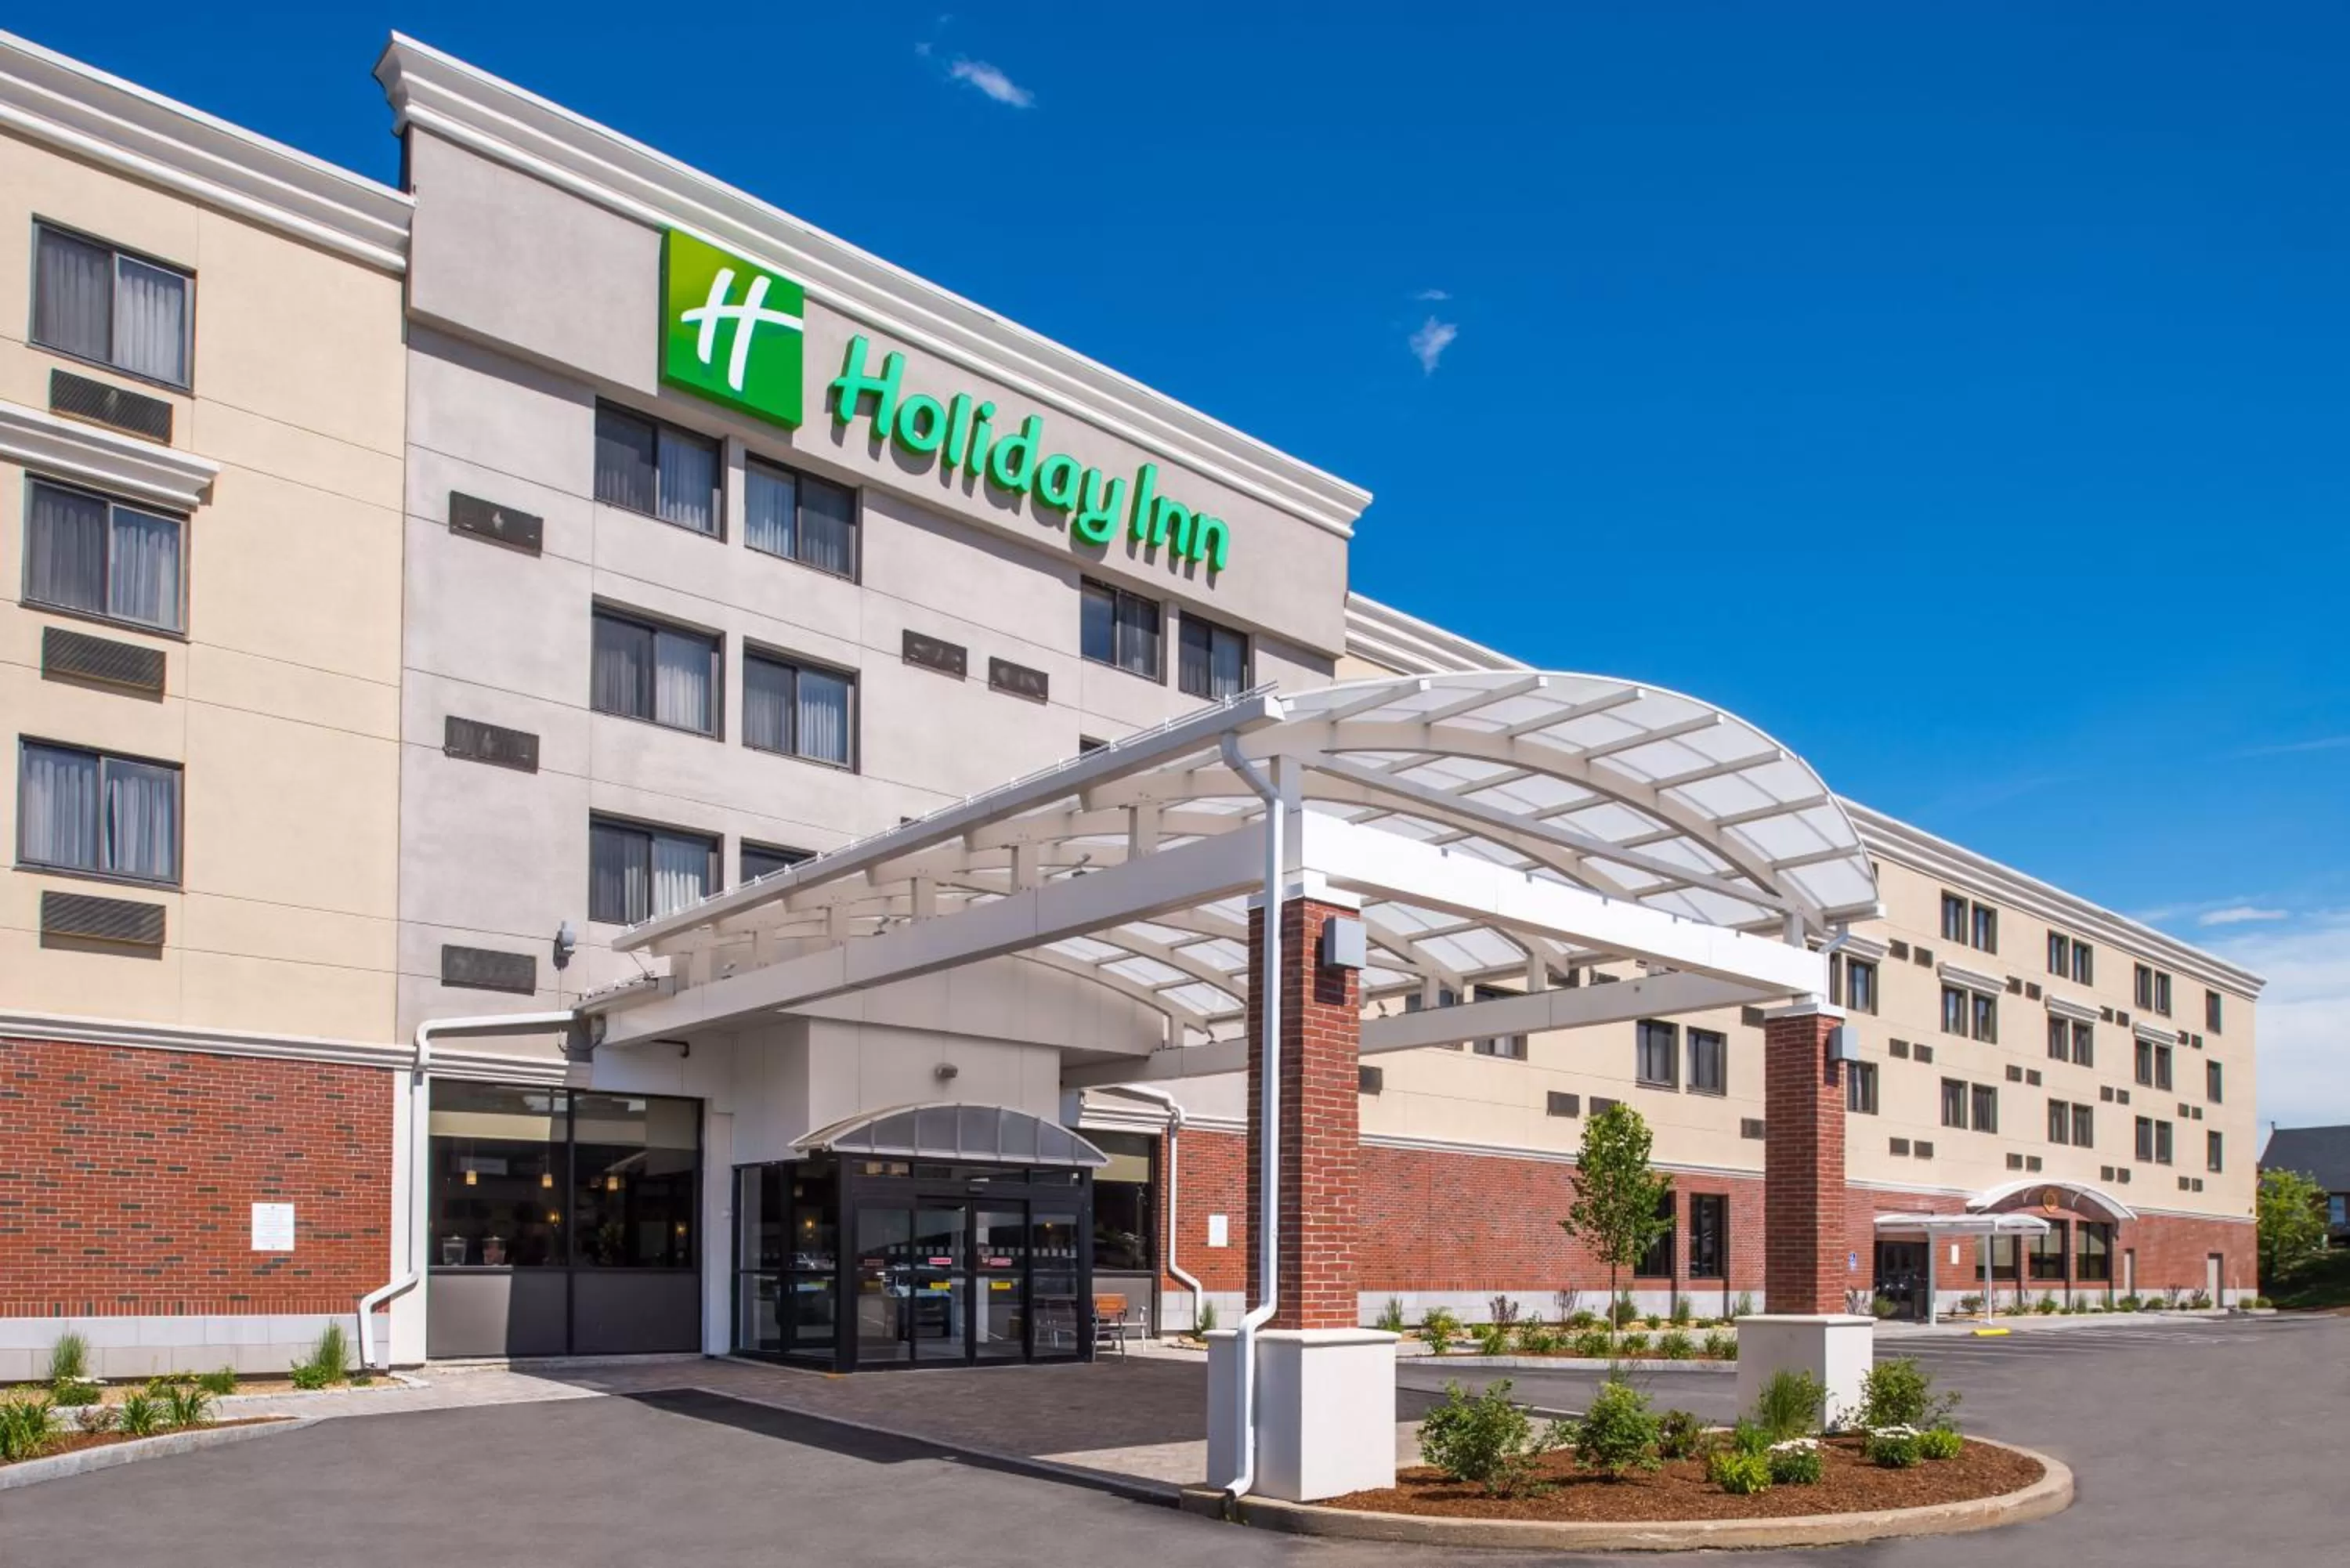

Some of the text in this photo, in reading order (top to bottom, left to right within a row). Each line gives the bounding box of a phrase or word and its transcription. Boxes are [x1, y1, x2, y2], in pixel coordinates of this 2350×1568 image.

[680, 267, 803, 392] H
[828, 334, 1230, 573] Holiday Inn
